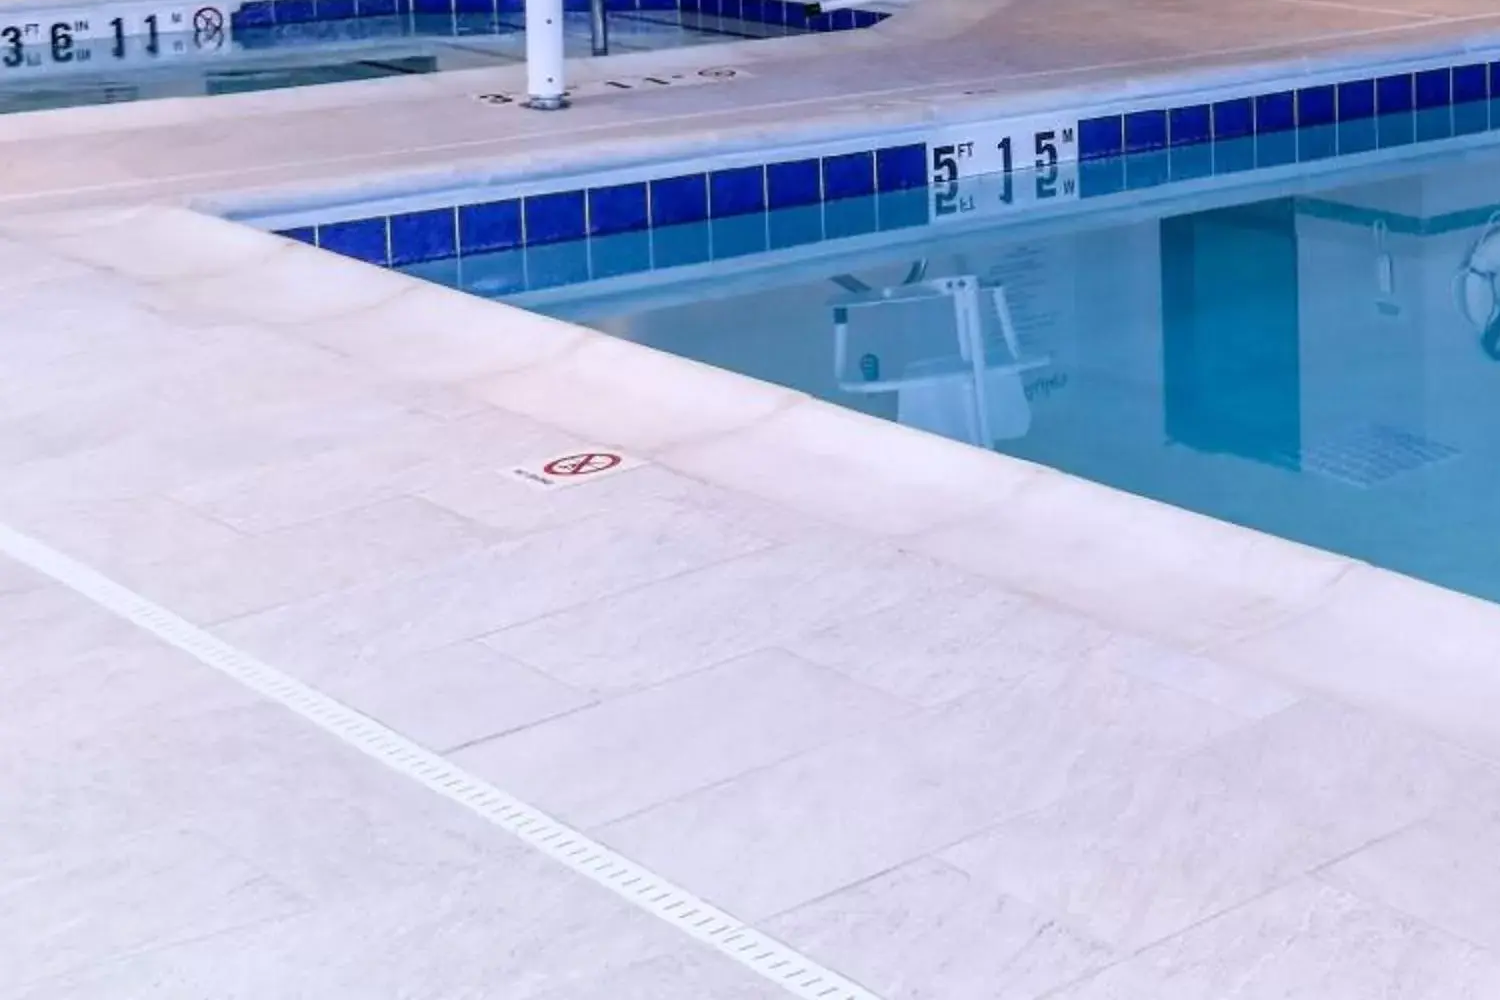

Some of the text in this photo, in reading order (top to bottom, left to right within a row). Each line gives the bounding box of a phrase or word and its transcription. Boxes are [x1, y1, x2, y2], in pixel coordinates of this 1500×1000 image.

[2, 25, 24, 50] 3
[51, 22, 73, 48] 6
[934, 145, 958, 183] 5
[957, 142, 974, 158] FT
[1062, 127, 1073, 143] M
